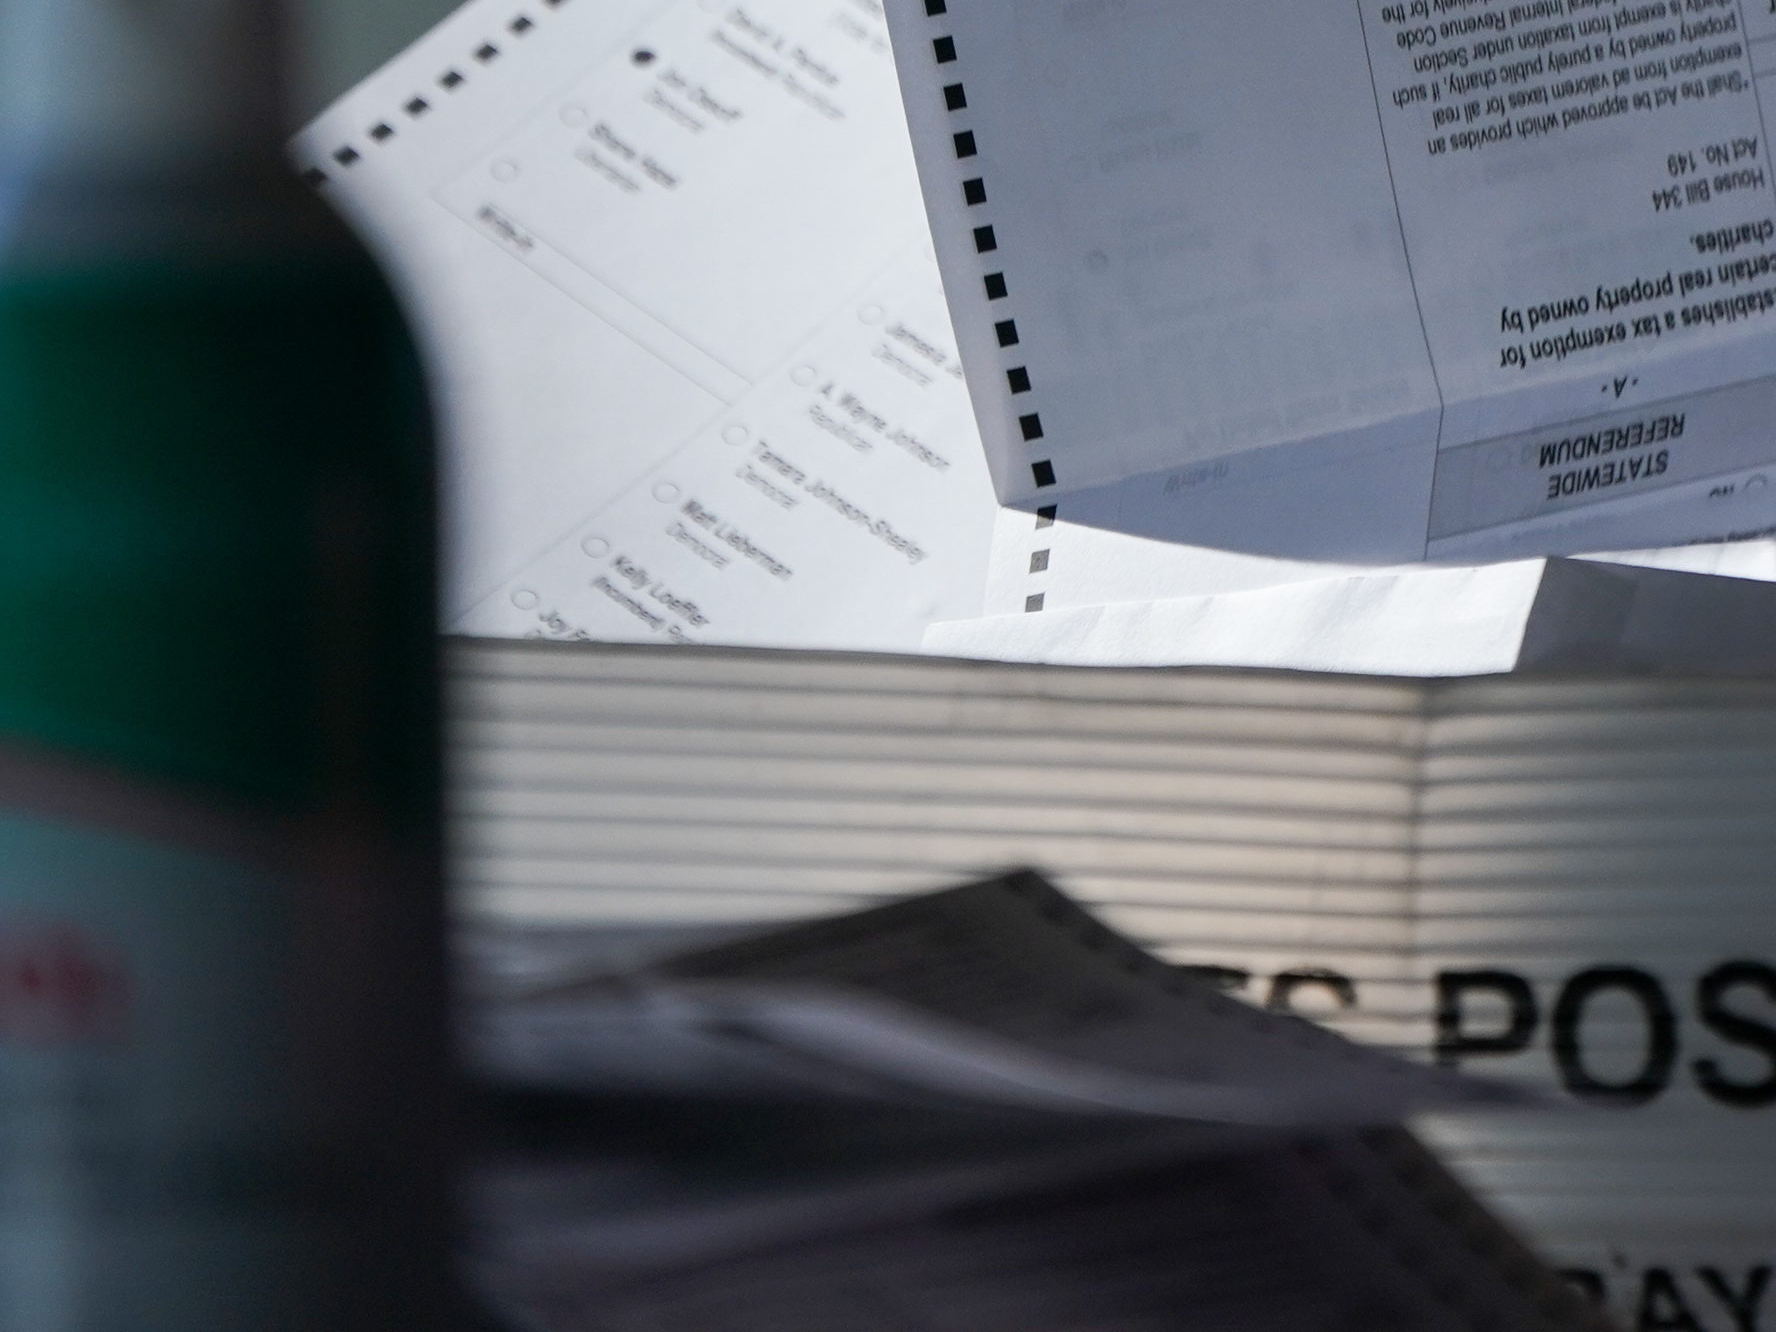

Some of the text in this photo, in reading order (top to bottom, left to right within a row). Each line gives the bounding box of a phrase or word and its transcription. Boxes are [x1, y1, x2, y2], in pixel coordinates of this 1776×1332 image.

[1381, 3, 1406, 24] the
[1439, 10, 1507, 39] Revenue
[1577, 15, 1612, 37] from
[1613, 2, 1667, 31] exempt
[1396, 25, 1437, 51] Code
[1473, 36, 1515, 61] under
[1517, 23, 1576, 50] taxation
[1392, 10, 1738, 110] property owned by a purely public charity, if such
[1413, 46, 1469, 74] Section
[1432, 42, 1743, 130] exemption from ad valorem taxes for all real
[1653, 85, 1678, 109] Act
[1680, 79, 1705, 100] the
[1561, 94, 1629, 130] approved
[1632, 91, 1653, 111] be
[1449, 118, 1513, 151] provides
[1515, 112, 1559, 140] which
[1427, 136, 1447, 156] an
[1667, 136, 1758, 178] Act No. 149
[1651, 167, 1766, 213] House Bill 344
[1689, 218, 1775, 255] charities.
[1595, 271, 1674, 314] property
[1678, 267, 1714, 298] real
[1500, 306, 1525, 334] by
[1527, 295, 1590, 332] owned
[1631, 314, 1662, 338] tax
[1663, 310, 1676, 331] a
[1529, 322, 1627, 361] exemption
[1500, 344, 1527, 369] for
[1538, 413, 1686, 469] REFERENDUM
[1547, 449, 1669, 501] STATEWIDE
[1562, 1264, 1776, 1332] AY
